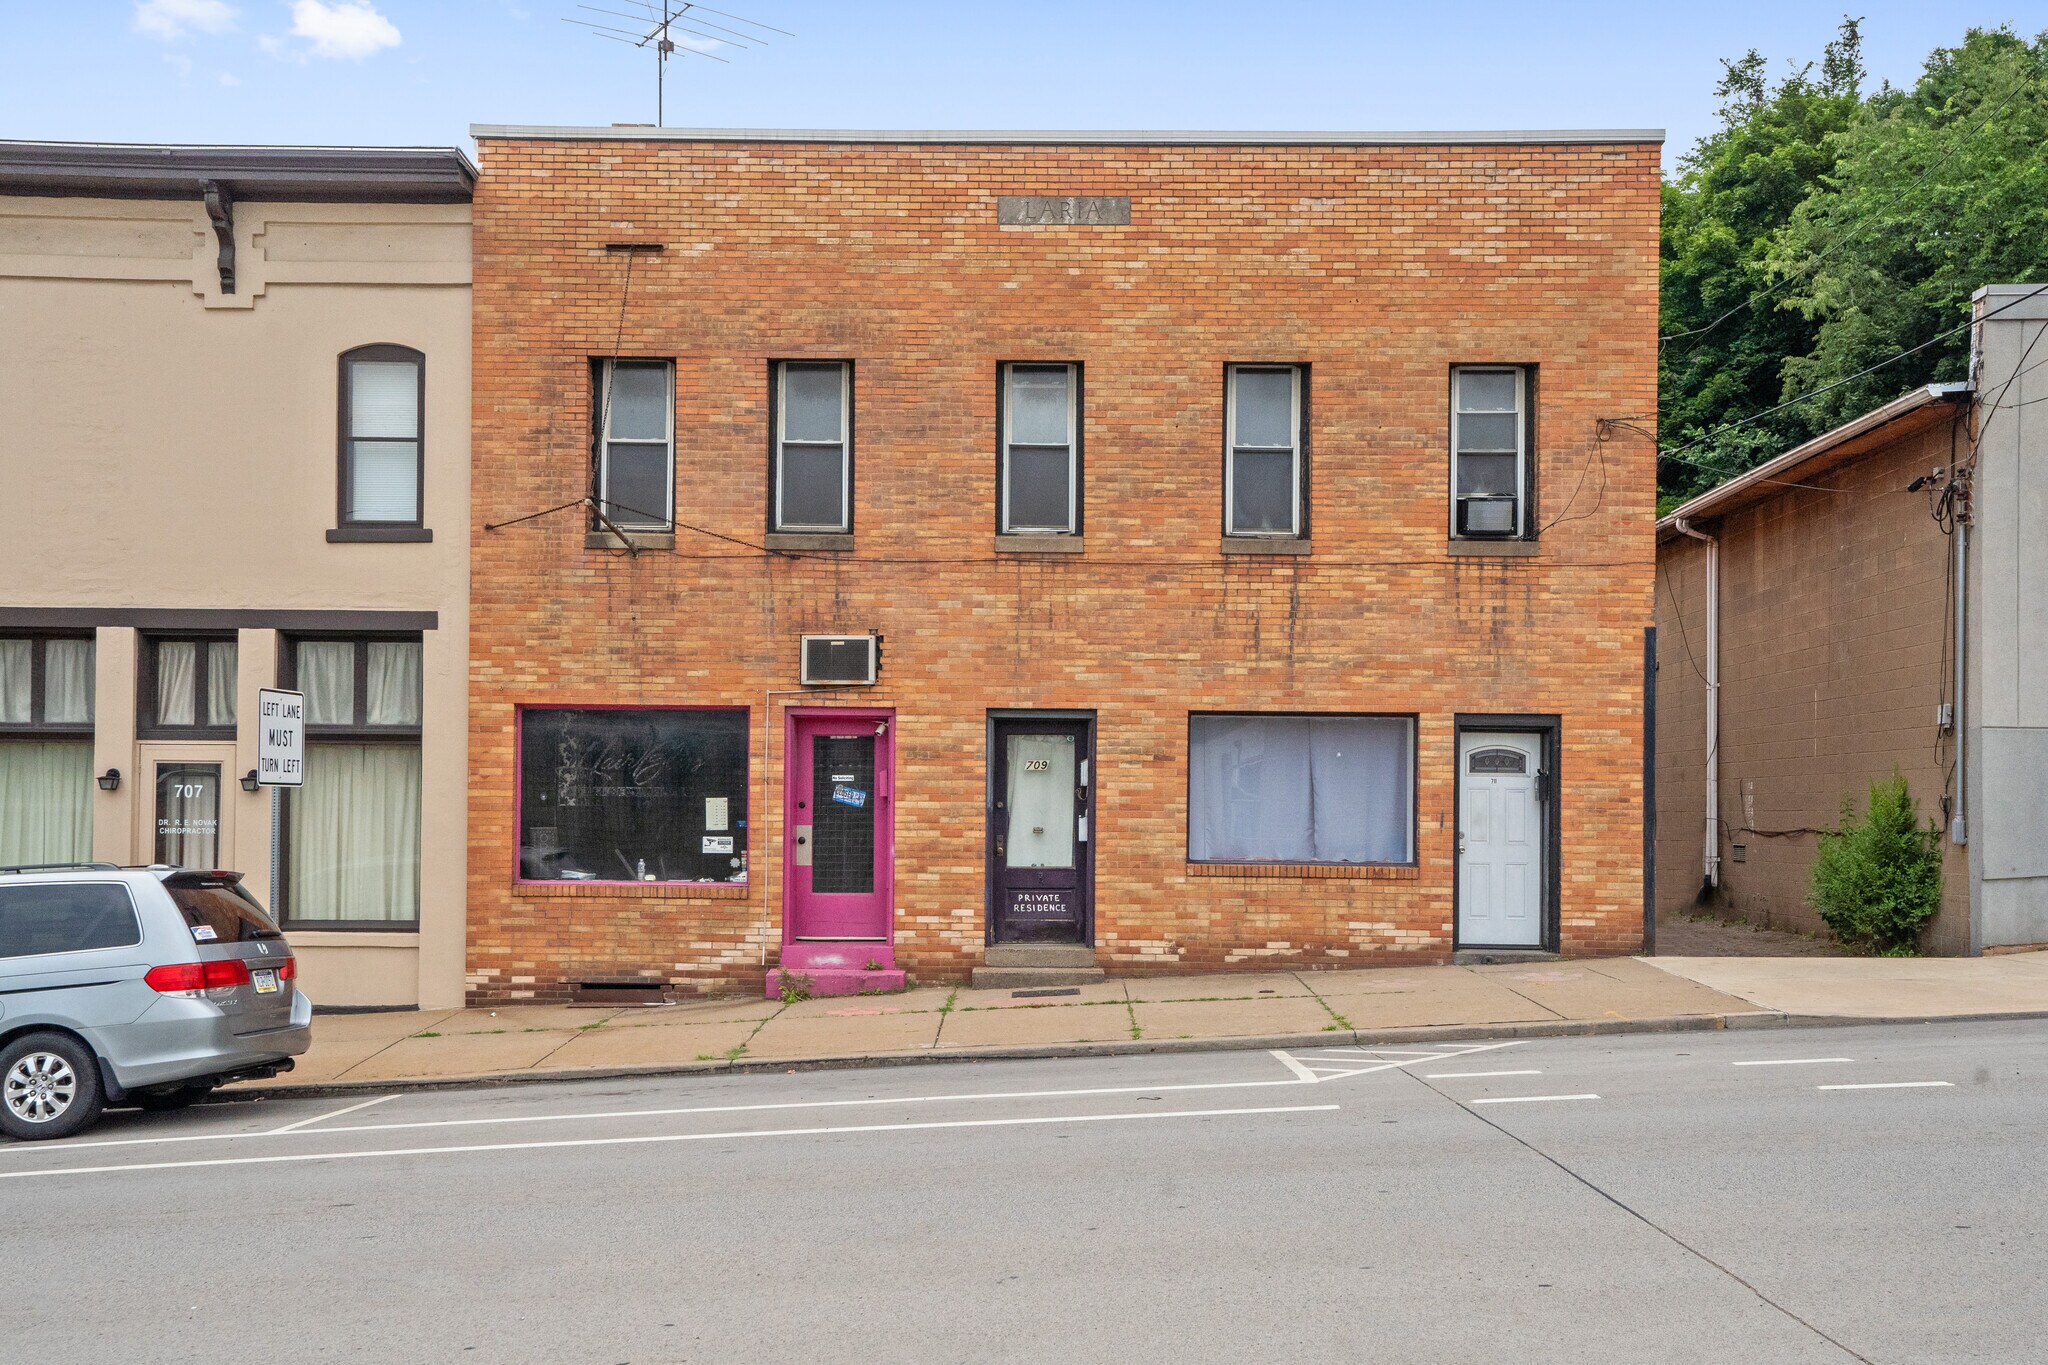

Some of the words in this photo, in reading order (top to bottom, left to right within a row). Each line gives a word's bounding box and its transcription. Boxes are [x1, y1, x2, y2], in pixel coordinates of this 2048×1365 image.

[1025, 200, 1103, 220] LARIA
[263, 702, 279, 717] LEFT
[283, 704, 300, 719] LANE
[269, 729, 293, 747] MUST
[262, 758, 278, 772] TURN
[283, 759, 300, 773] LEFT
[1026, 761, 1048, 770] 709
[174, 784, 203, 798] 707
[159, 827, 216, 835] CHIROPRACTOR
[1018, 894, 1060, 902] PRIVATE
[1013, 903, 1067, 912] RESIDENCE
